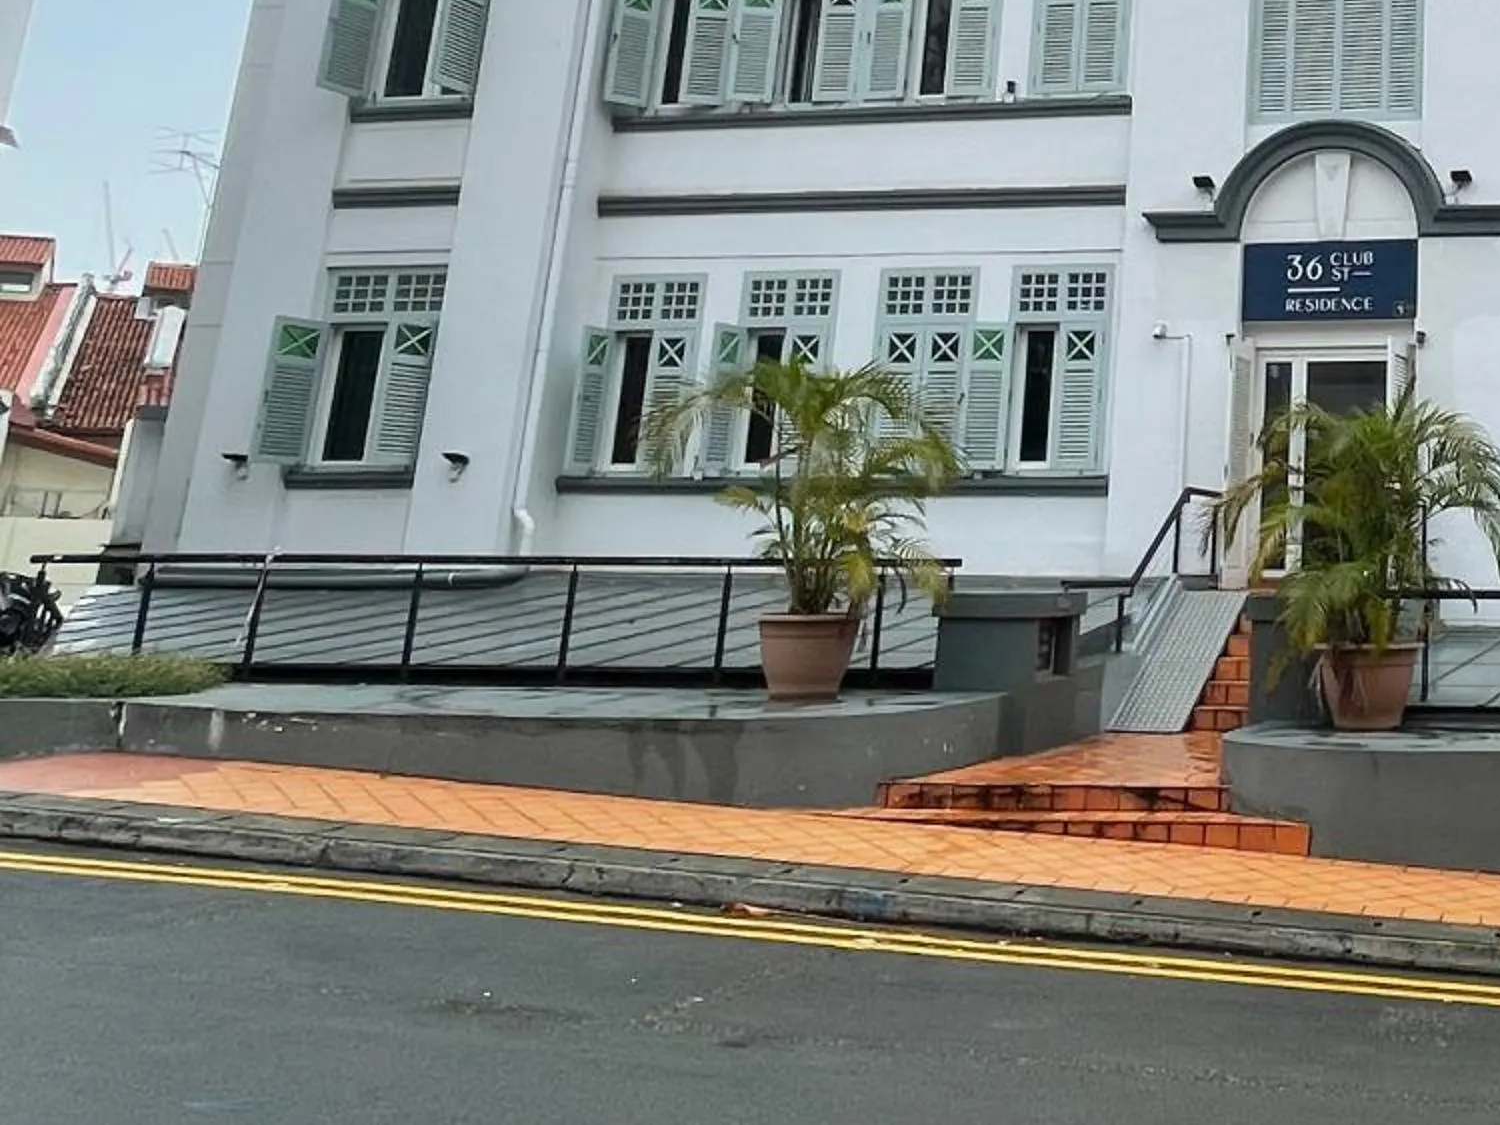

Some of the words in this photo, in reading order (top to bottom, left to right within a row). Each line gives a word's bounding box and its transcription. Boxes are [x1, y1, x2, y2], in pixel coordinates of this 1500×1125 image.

[1287, 254, 1323, 282] 36
[1329, 250, 1374, 266] CLUB
[1285, 297, 1374, 312] RESIDENCE
